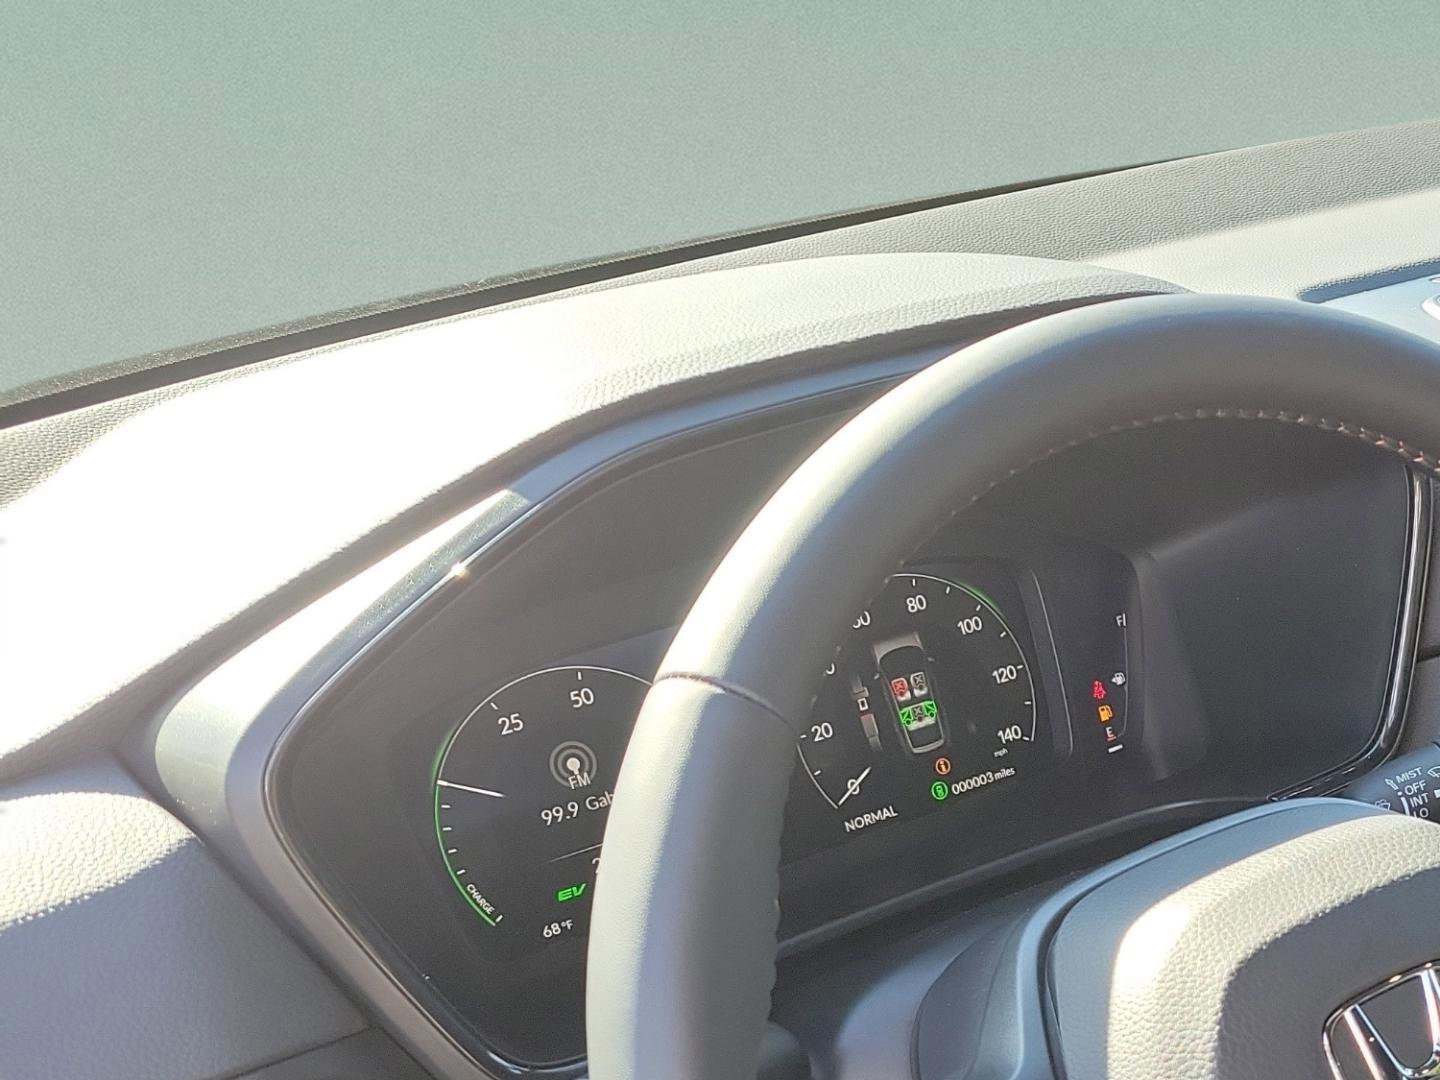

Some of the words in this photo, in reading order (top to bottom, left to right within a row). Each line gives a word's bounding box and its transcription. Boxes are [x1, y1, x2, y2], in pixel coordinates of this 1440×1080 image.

[906, 595, 927, 613] 80
[957, 615, 983, 635] 100
[992, 664, 1018, 684] 120
[570, 687, 595, 709] 50
[497, 713, 524, 736] 25
[811, 722, 833, 743] 20
[997, 725, 1022, 745] 140
[994, 748, 1009, 758] mph
[568, 772, 592, 790] FM
[951, 771, 994, 795] 000003
[994, 767, 1016, 781] miles
[1395, 767, 1423, 783] MIST
[1404, 780, 1427, 795] OFF
[1410, 793, 1430, 807] INT
[541, 801, 579, 826] 99.9
[844, 805, 899, 832] NORMAL
[466, 883, 495, 915] CHARGE
[557, 883, 587, 902] EV
